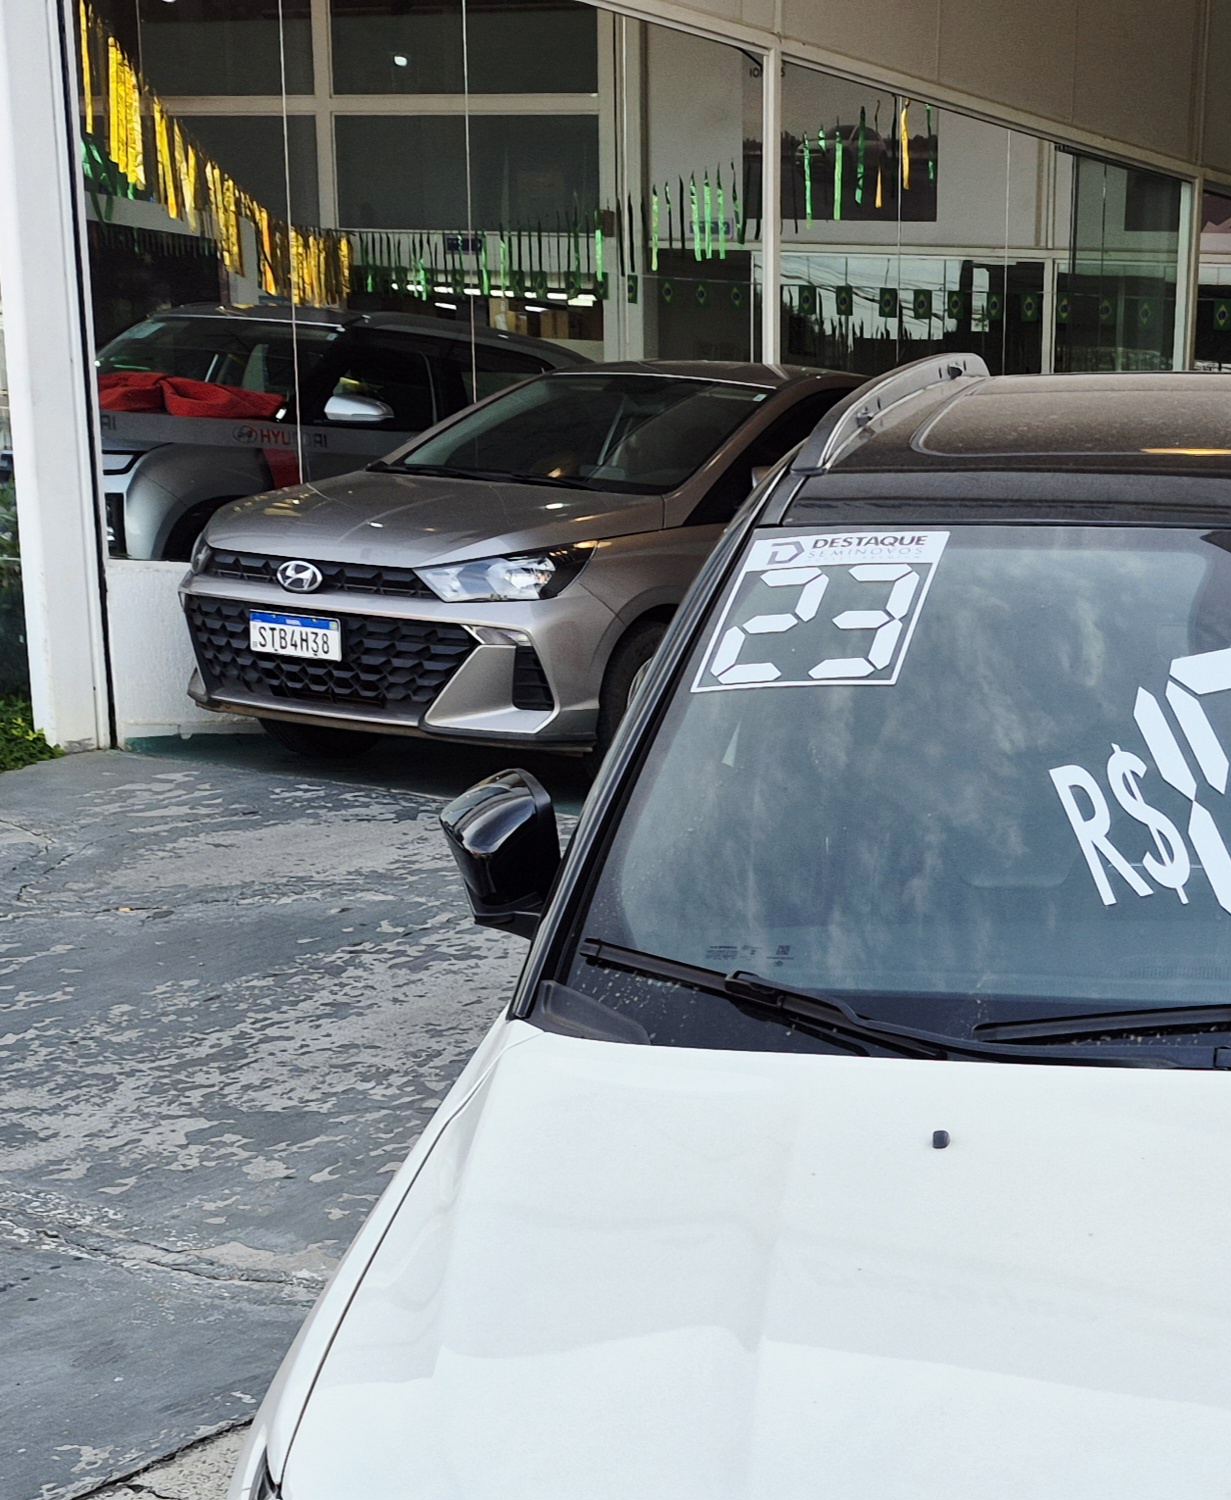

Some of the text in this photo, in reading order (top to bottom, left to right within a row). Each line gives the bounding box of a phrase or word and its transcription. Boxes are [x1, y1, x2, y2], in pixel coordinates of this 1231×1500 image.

[812, 535, 929, 549] DESTAQUE
[808, 547, 924, 559] SEMINOVOS
[710, 563, 920, 685] 23
[258, 626, 330, 655] STB4H38
